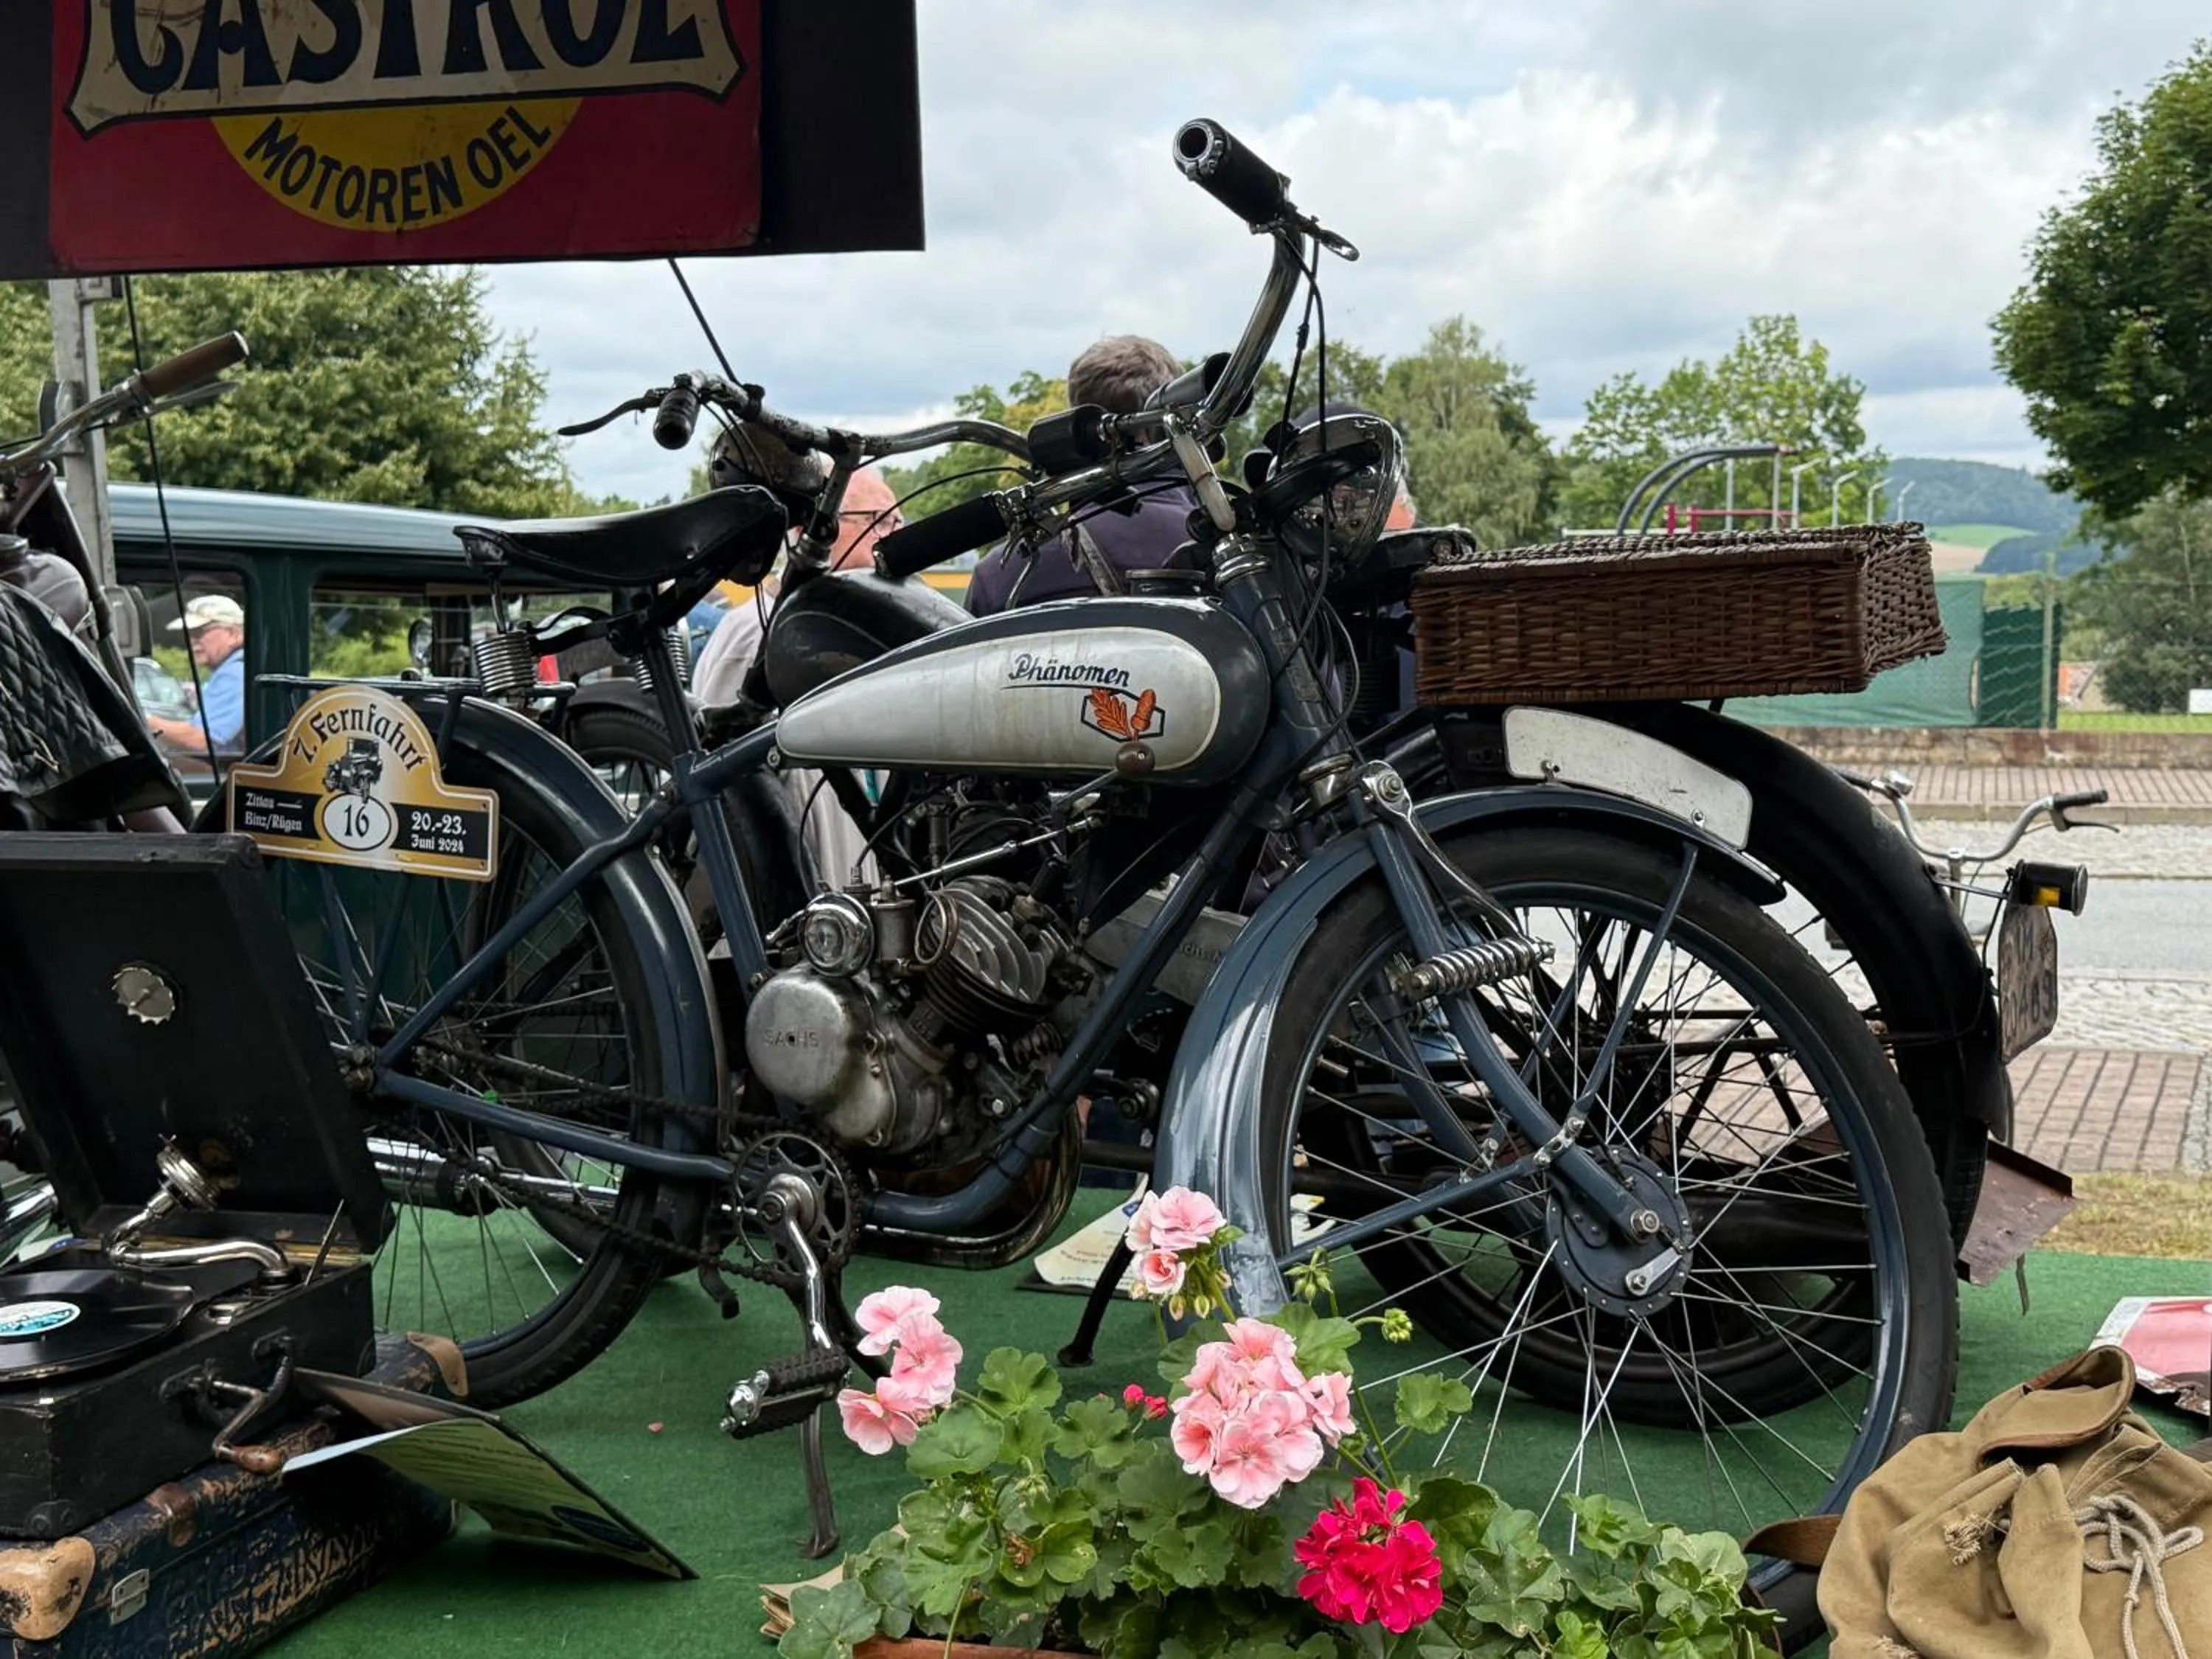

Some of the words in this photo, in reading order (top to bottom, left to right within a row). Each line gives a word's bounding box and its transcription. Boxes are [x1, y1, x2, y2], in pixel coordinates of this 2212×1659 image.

[244, 116, 464, 223] MOTOREN
[466, 105, 552, 189] OEL
[1008, 653, 1130, 687] Phänomen
[293, 737, 318, 764] 7.
[309, 703, 426, 771] Fernfahrt
[245, 792, 275, 809] Zittau
[244, 810, 303, 832] Binz/Rügen
[344, 804, 369, 838] 16
[411, 811, 467, 835] 20.-23.
[411, 834, 435, 850] Juni
[437, 838, 464, 853] 2024
